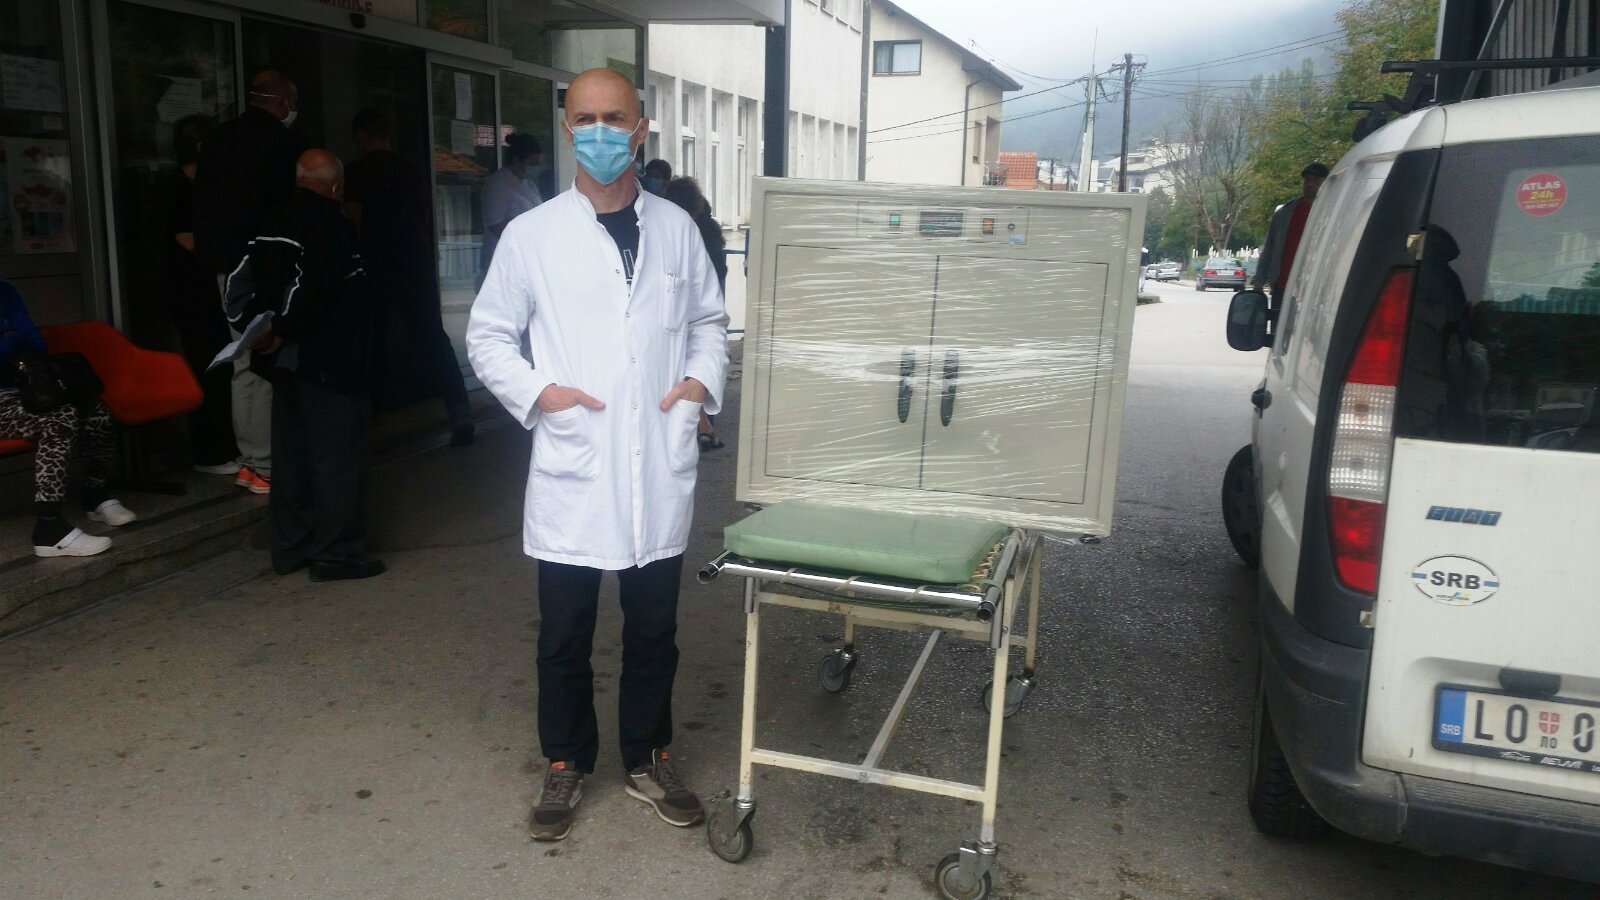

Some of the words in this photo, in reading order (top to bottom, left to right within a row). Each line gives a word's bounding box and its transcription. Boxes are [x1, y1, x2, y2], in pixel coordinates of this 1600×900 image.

[1521, 181, 1561, 191] ATLAS
[1530, 191, 1554, 200] 24h
[1429, 507, 1499, 524] FIAT
[1430, 570, 1481, 590] SRB
[1474, 699, 1529, 744] LO
[1440, 723, 1462, 736] SRB
